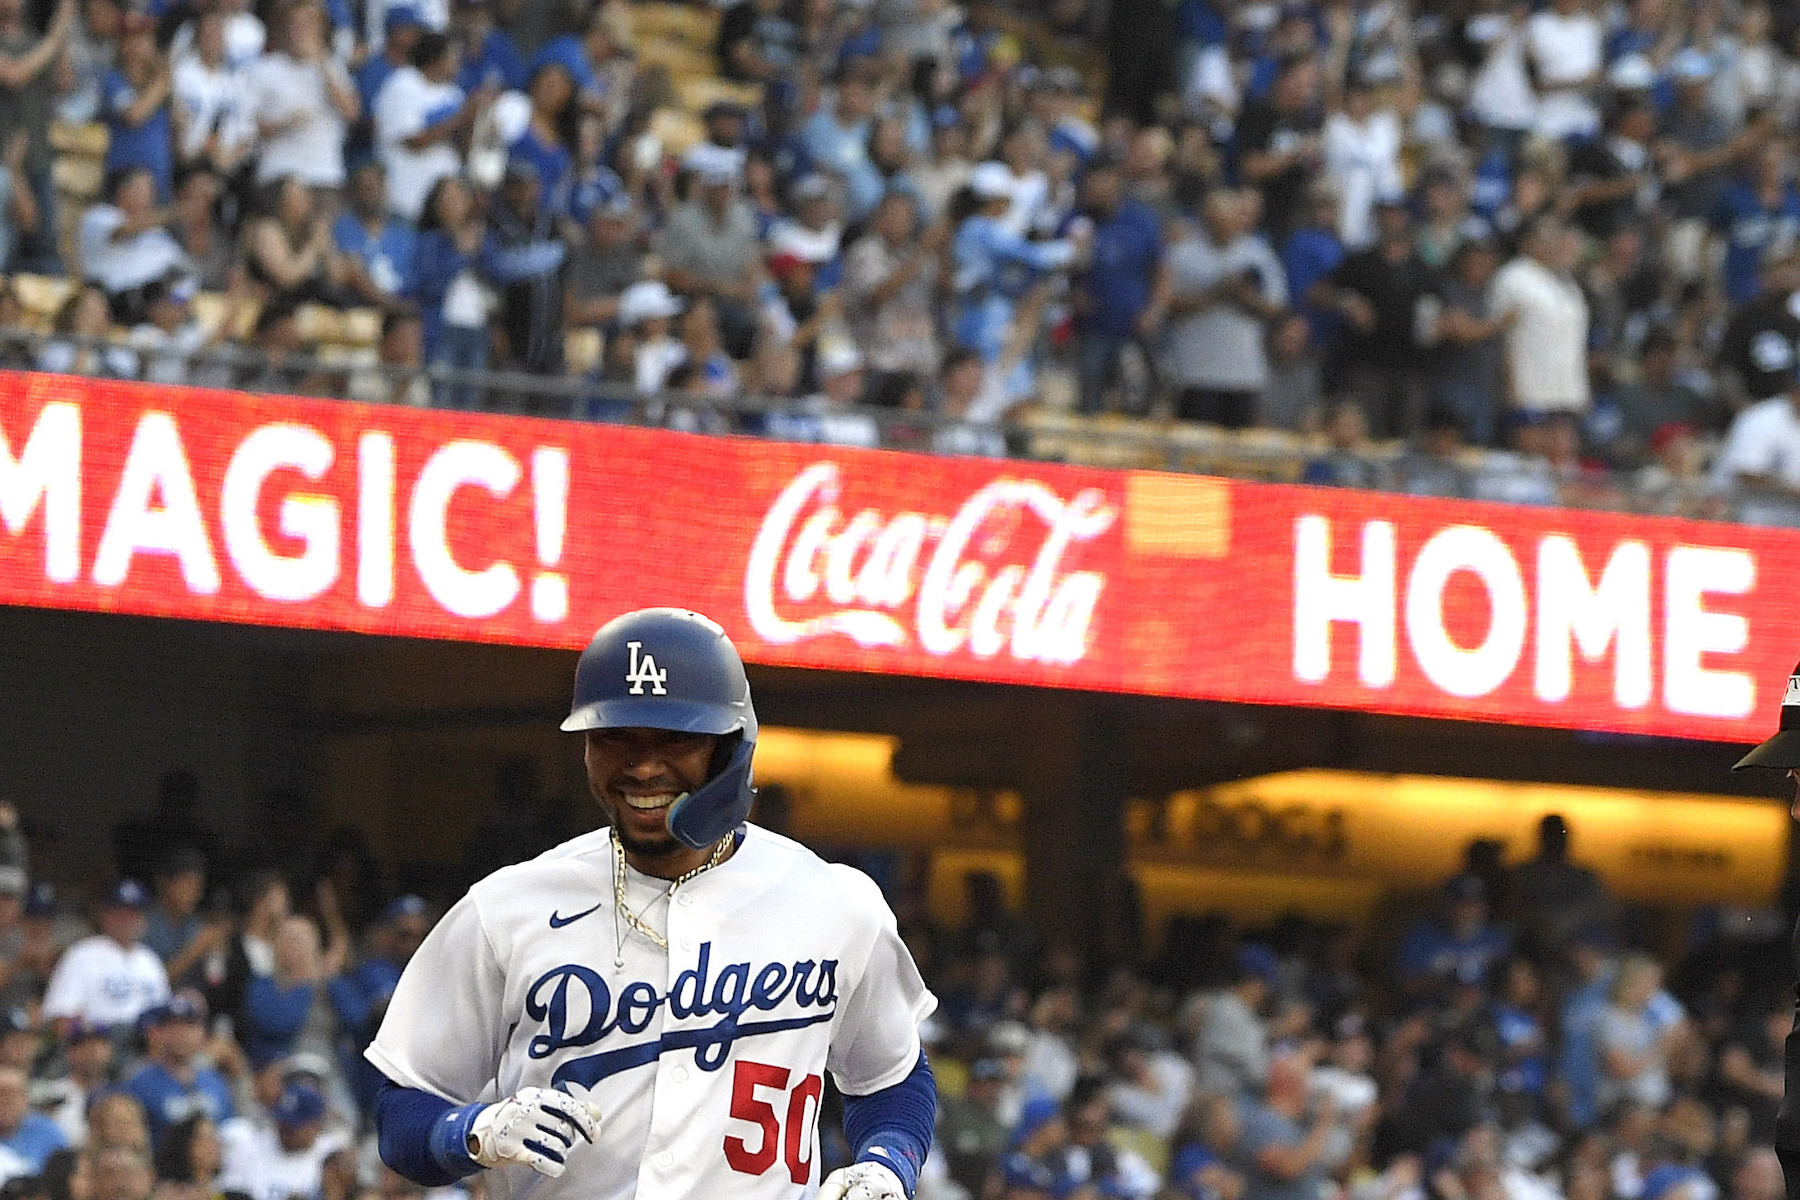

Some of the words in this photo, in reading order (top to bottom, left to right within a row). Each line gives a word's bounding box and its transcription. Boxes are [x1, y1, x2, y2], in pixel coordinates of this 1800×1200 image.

[626, 641, 667, 696] LA
[1293, 513, 1756, 718] HOME
[525, 942, 838, 1075] Dodgers
[723, 1060, 821, 1186] 50
